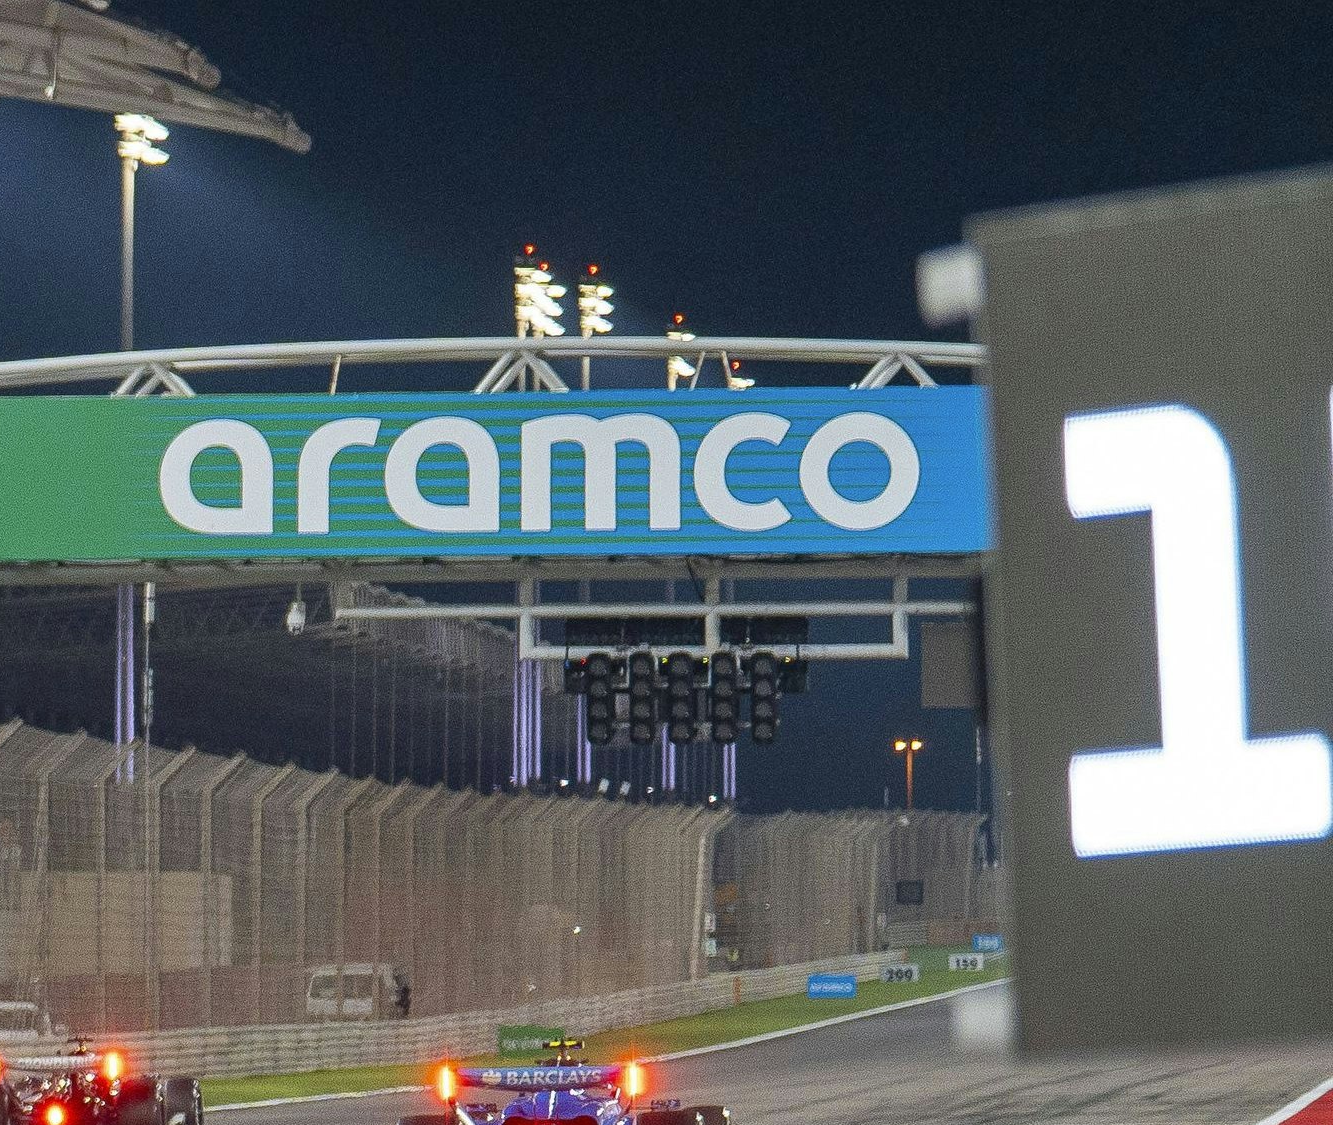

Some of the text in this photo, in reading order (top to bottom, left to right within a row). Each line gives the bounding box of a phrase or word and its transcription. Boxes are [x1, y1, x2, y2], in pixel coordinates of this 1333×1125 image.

[159, 412, 921, 536] aramco
[1064, 388, 1333, 858] 1
[505, 1069, 602, 1086] BARCLAYS
